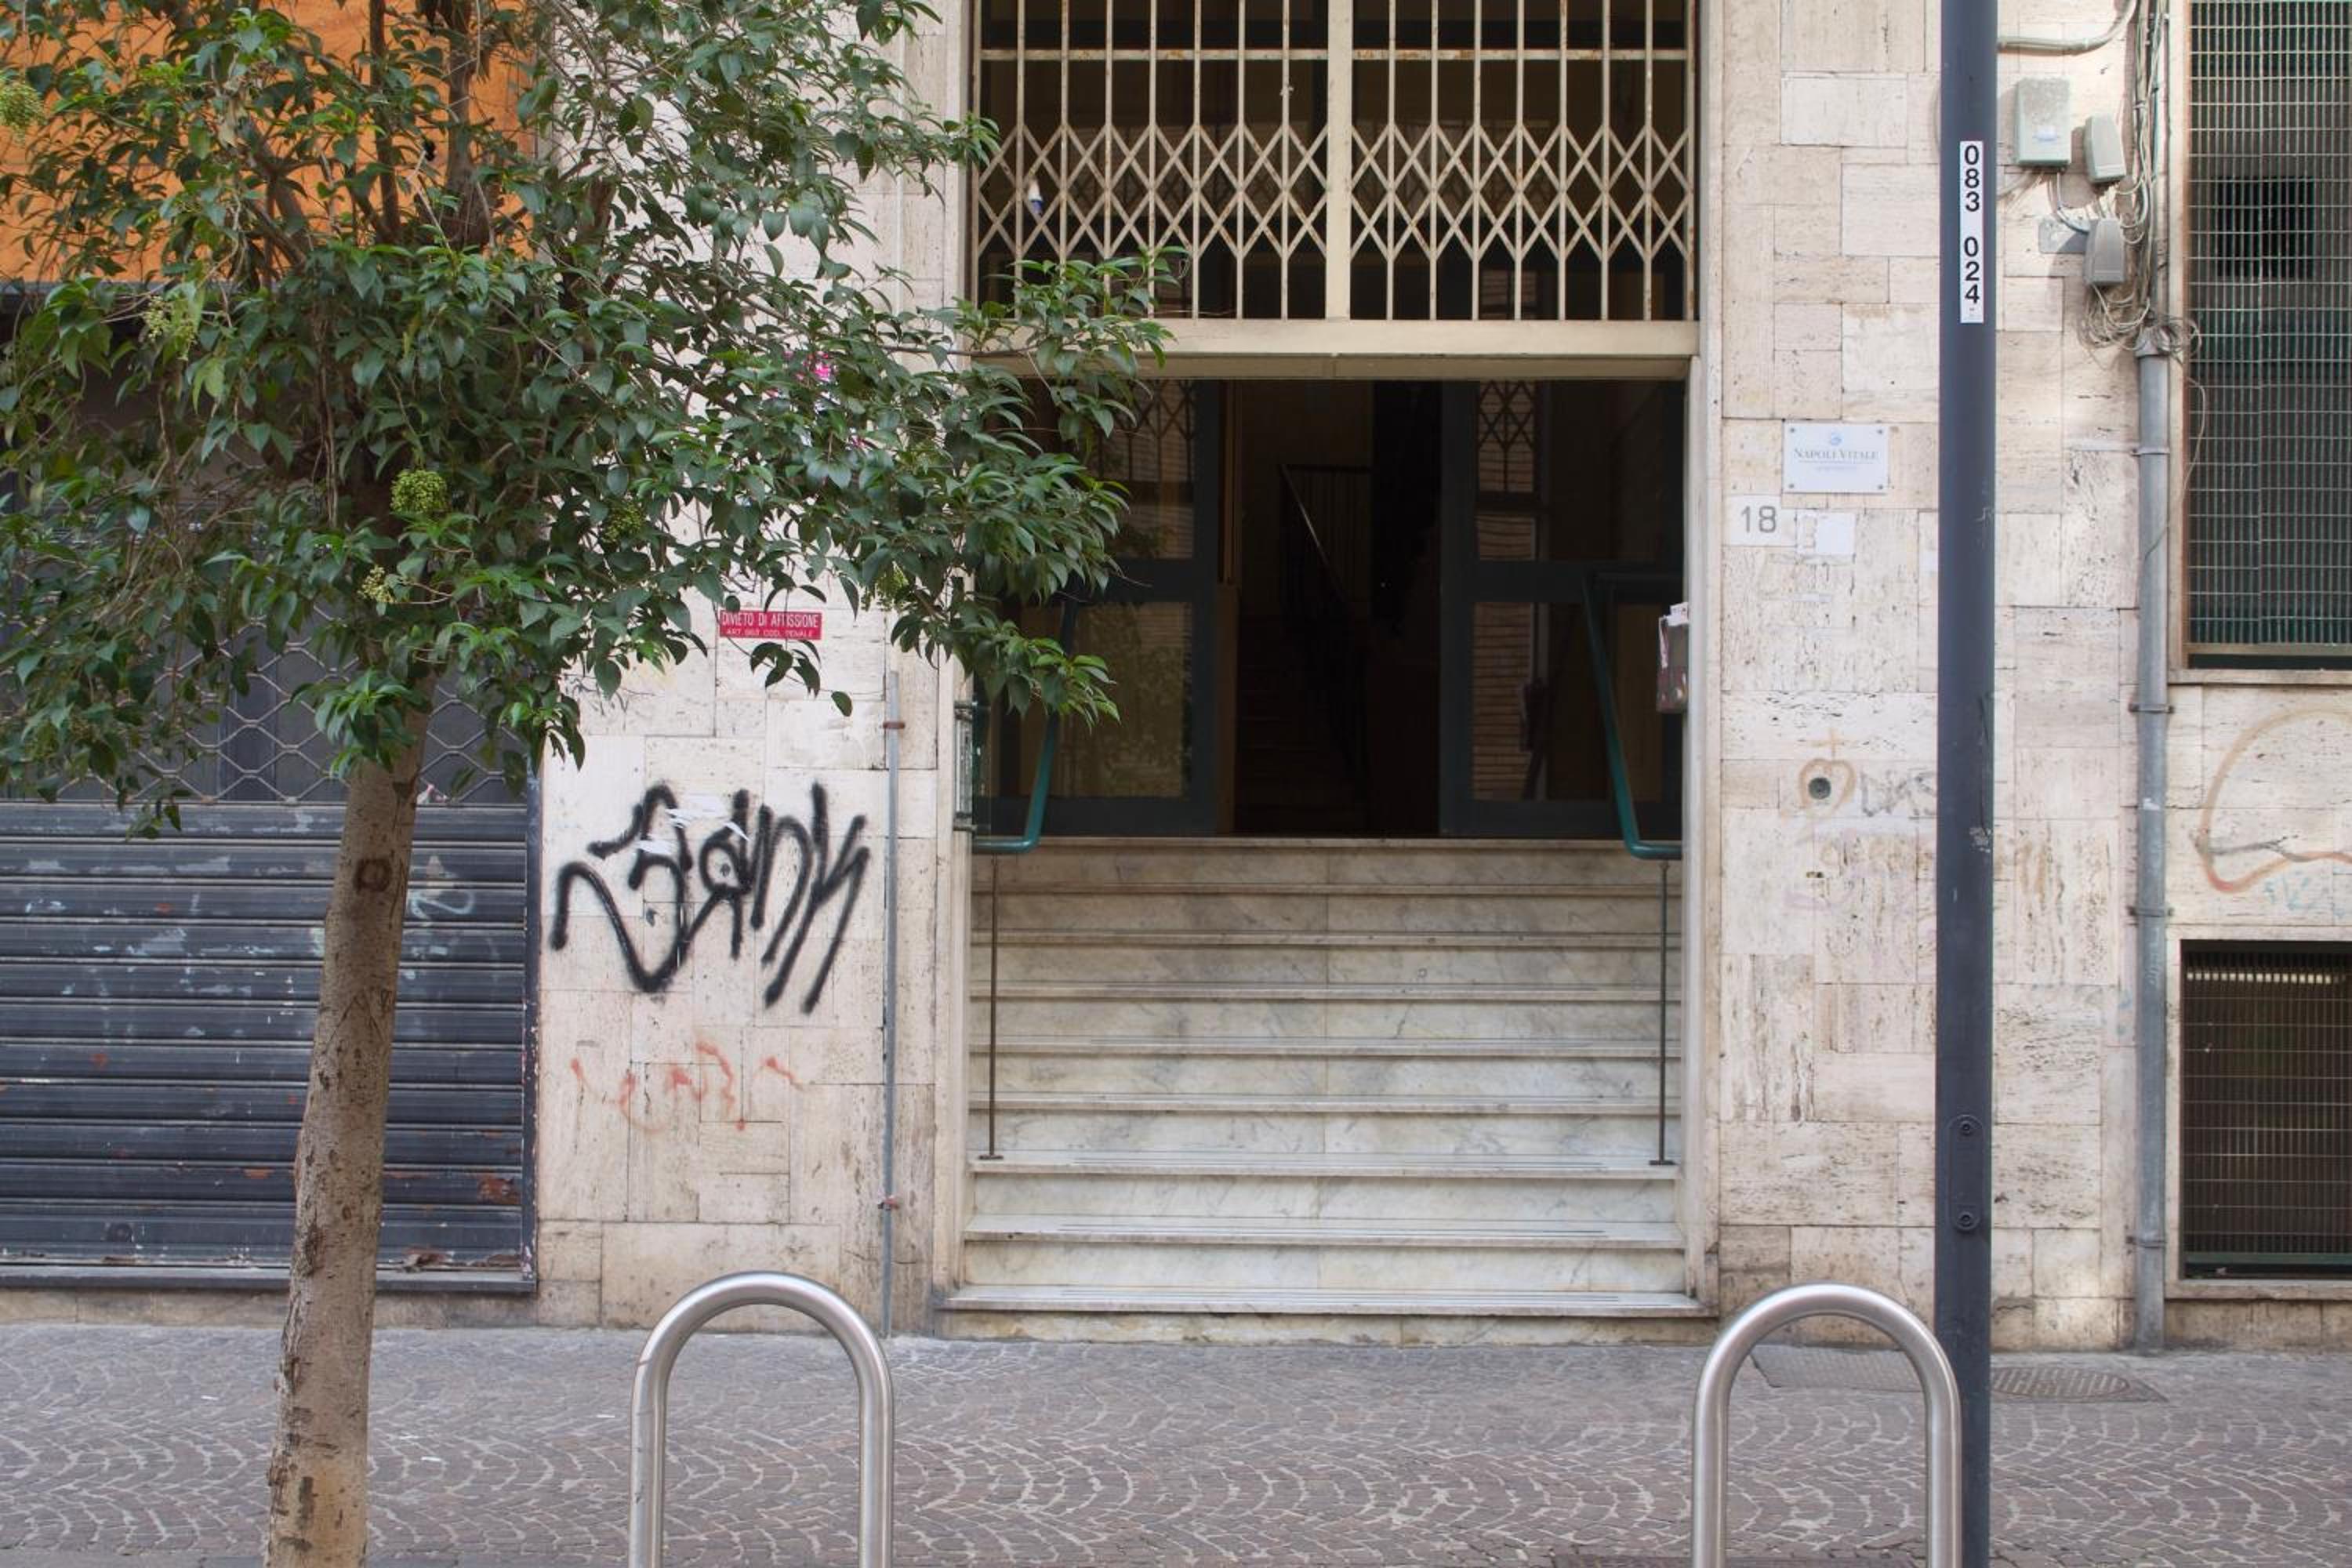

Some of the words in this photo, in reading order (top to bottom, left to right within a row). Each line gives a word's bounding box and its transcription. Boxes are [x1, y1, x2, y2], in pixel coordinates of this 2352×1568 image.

[1964, 144, 1980, 212] 083
[1964, 236, 1980, 304] 024
[1740, 505, 1777, 534] 18
[722, 612, 754, 626] DIVIETO
[758, 612, 767, 627] DI
[771, 613, 819, 628] AFFISSIONE
